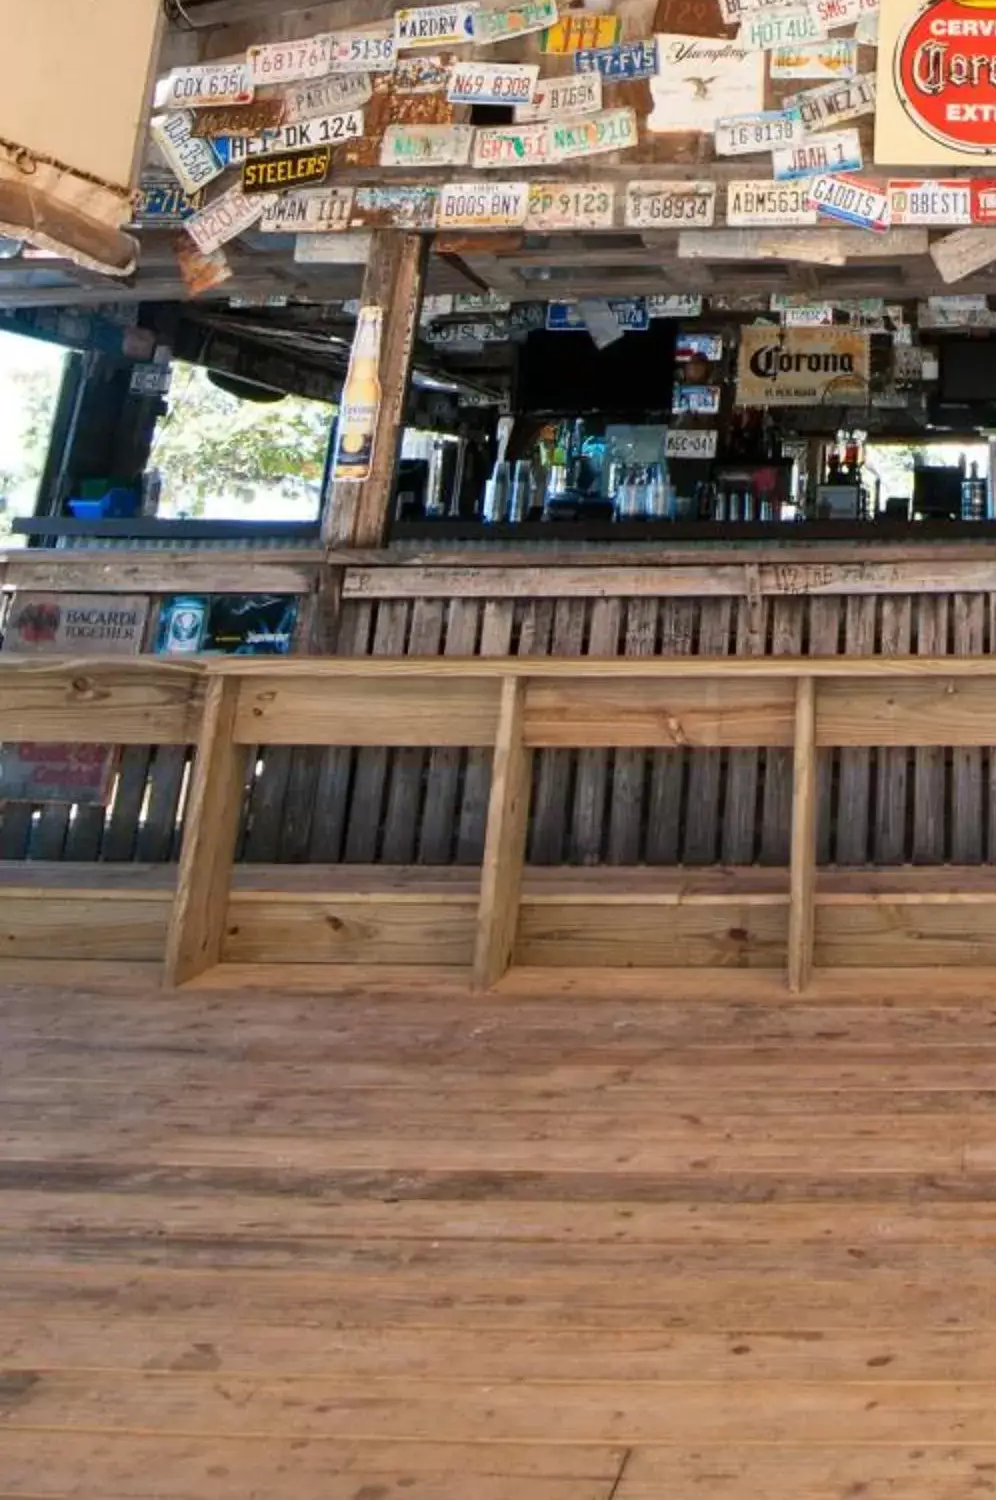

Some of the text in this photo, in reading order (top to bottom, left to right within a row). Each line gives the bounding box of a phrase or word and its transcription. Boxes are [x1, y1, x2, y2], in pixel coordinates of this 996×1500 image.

[245, 156, 328, 185] STEELERS
[749, 342, 854, 382] Corona
[65, 608, 138, 626] BACARDI
